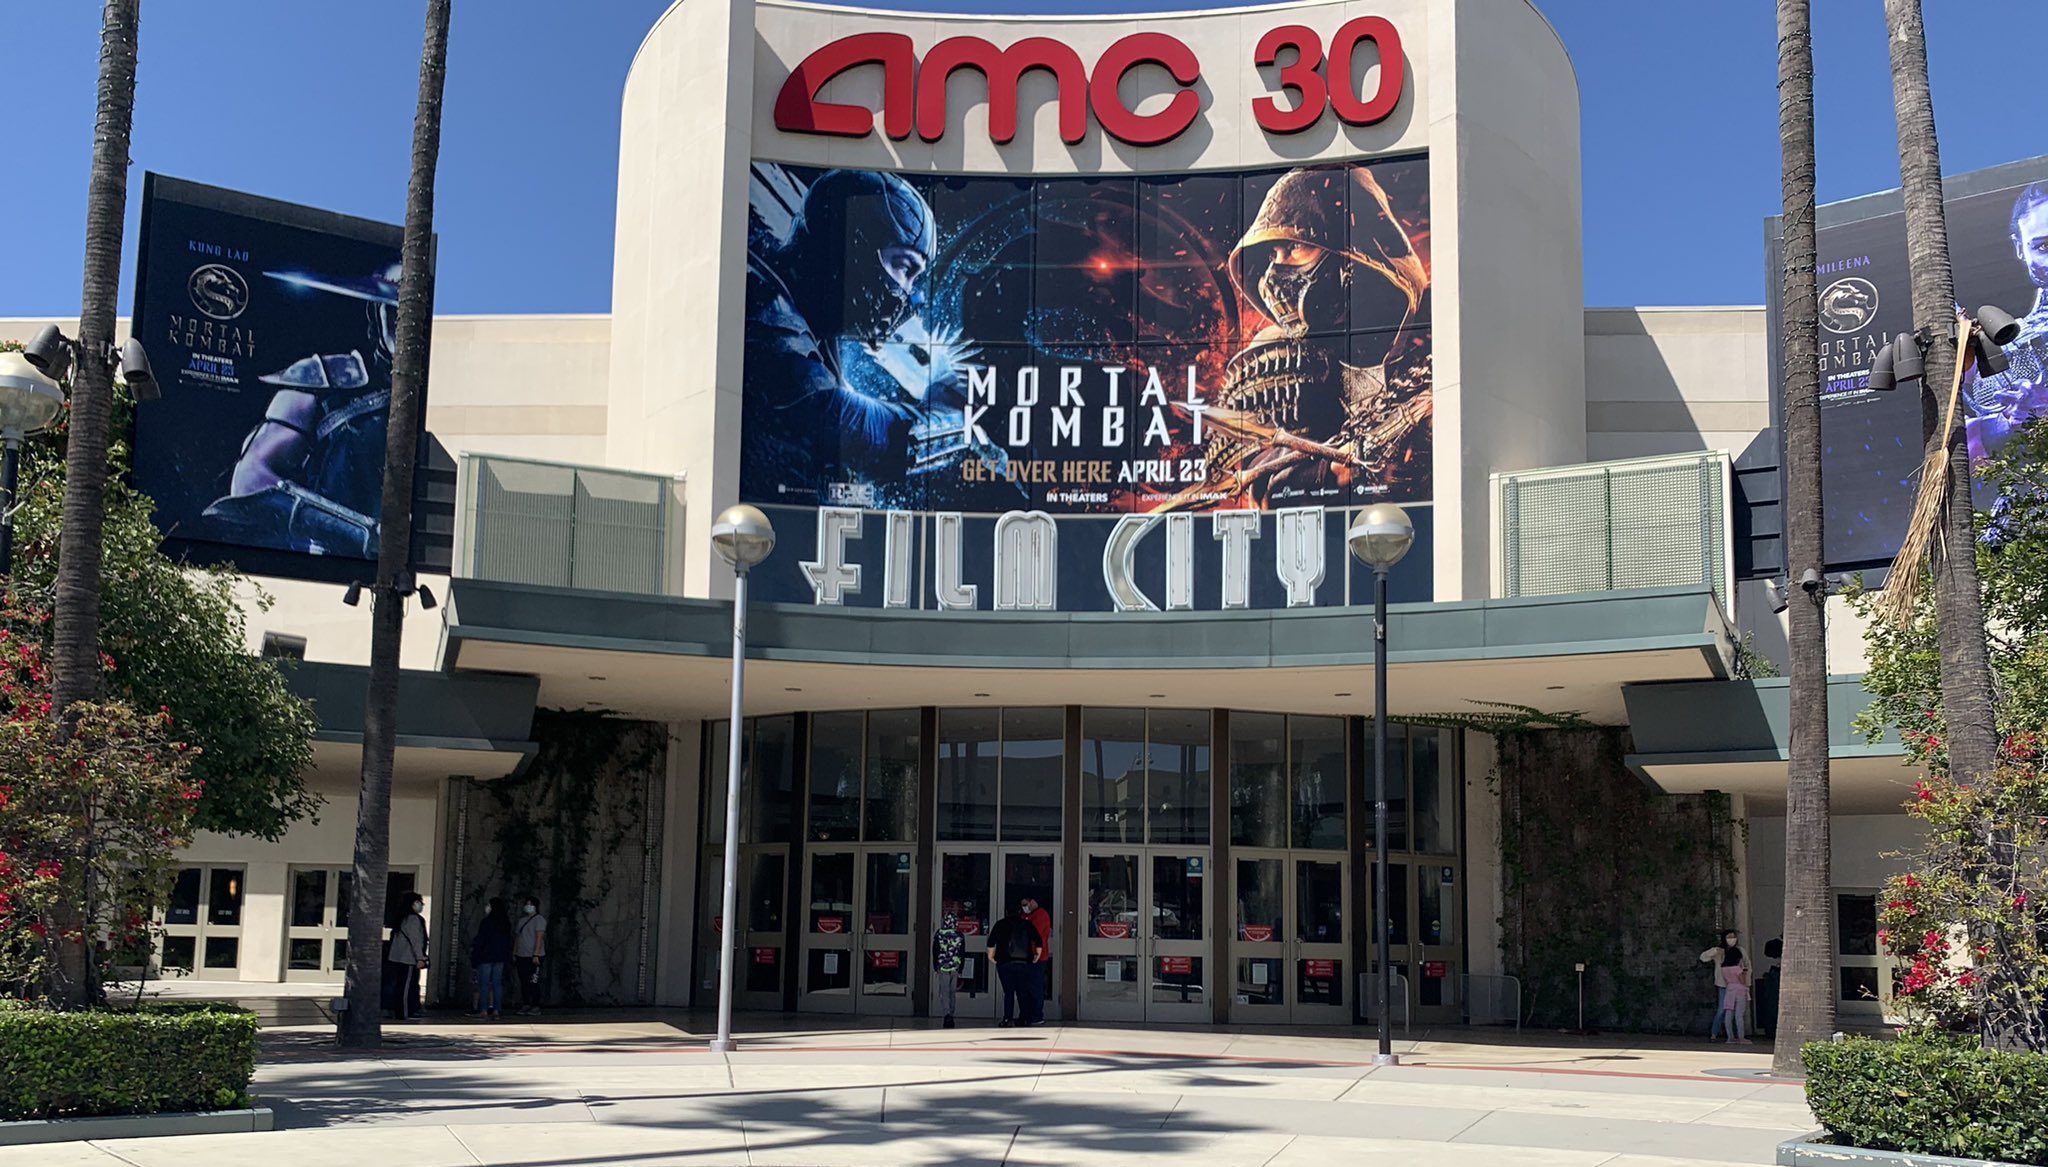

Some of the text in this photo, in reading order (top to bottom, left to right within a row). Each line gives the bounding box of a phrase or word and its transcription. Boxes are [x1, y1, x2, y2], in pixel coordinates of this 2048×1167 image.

[1251, 15, 1403, 135] 30
[189, 239, 249, 262] KUNG LAO
[1816, 255, 1871, 275] MILEENA
[170, 314, 255, 344] MORTAL
[168, 329, 256, 358] KOMBAT
[1821, 331, 1890, 356] ORTAL
[188, 358, 235, 377] APRIL 23
[192, 352, 233, 366] IN THEATERS
[1818, 349, 1878, 372] OMBA
[967, 365, 1206, 407] MORTAL
[1836, 368, 1871, 381] THEATERS
[1825, 379, 1857, 394] APRIL
[963, 404, 1210, 447] KOMBAT
[962, 459, 1206, 482] GET OVER HERE APRIL 23
[1046, 492, 1108, 503] IN THEATERS
[1200, 491, 1228, 500] IMAX
[798, 505, 1327, 613] FILM CITY
[1104, 813, 1119, 822] E-1
